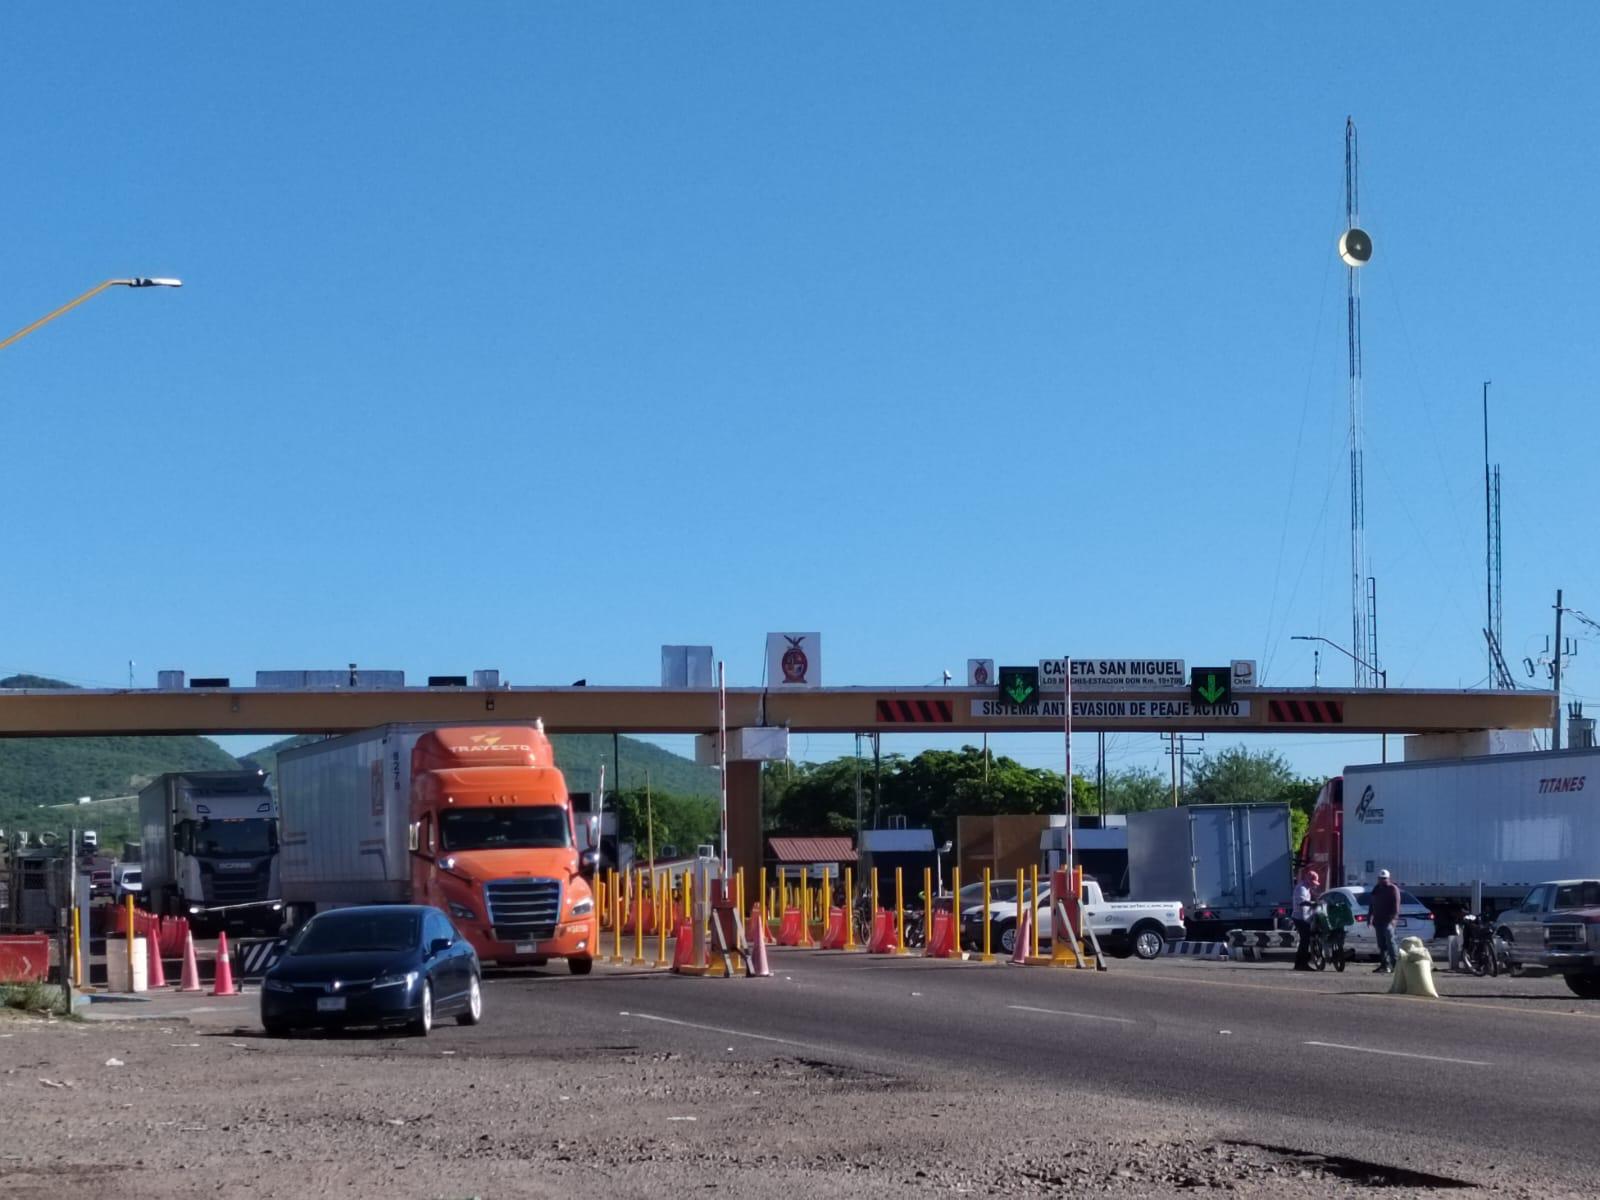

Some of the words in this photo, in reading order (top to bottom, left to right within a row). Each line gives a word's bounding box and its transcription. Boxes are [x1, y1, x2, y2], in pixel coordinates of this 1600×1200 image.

[1099, 661, 1126, 675] SAN
[1130, 661, 1182, 675] MIGUEL
[1058, 677, 1124, 685] MCHIS-ESTACION
[983, 702, 1038, 716] SISTEMA
[1042, 702, 1126, 716] ANTEVASION
[1130, 702, 1146, 716] DE
[1150, 702, 1190, 716] PEAJE
[1193, 702, 1240, 716] ACTIVO
[448, 744, 530, 753] TRAYECTO
[1538, 775, 1586, 794] TITANES
